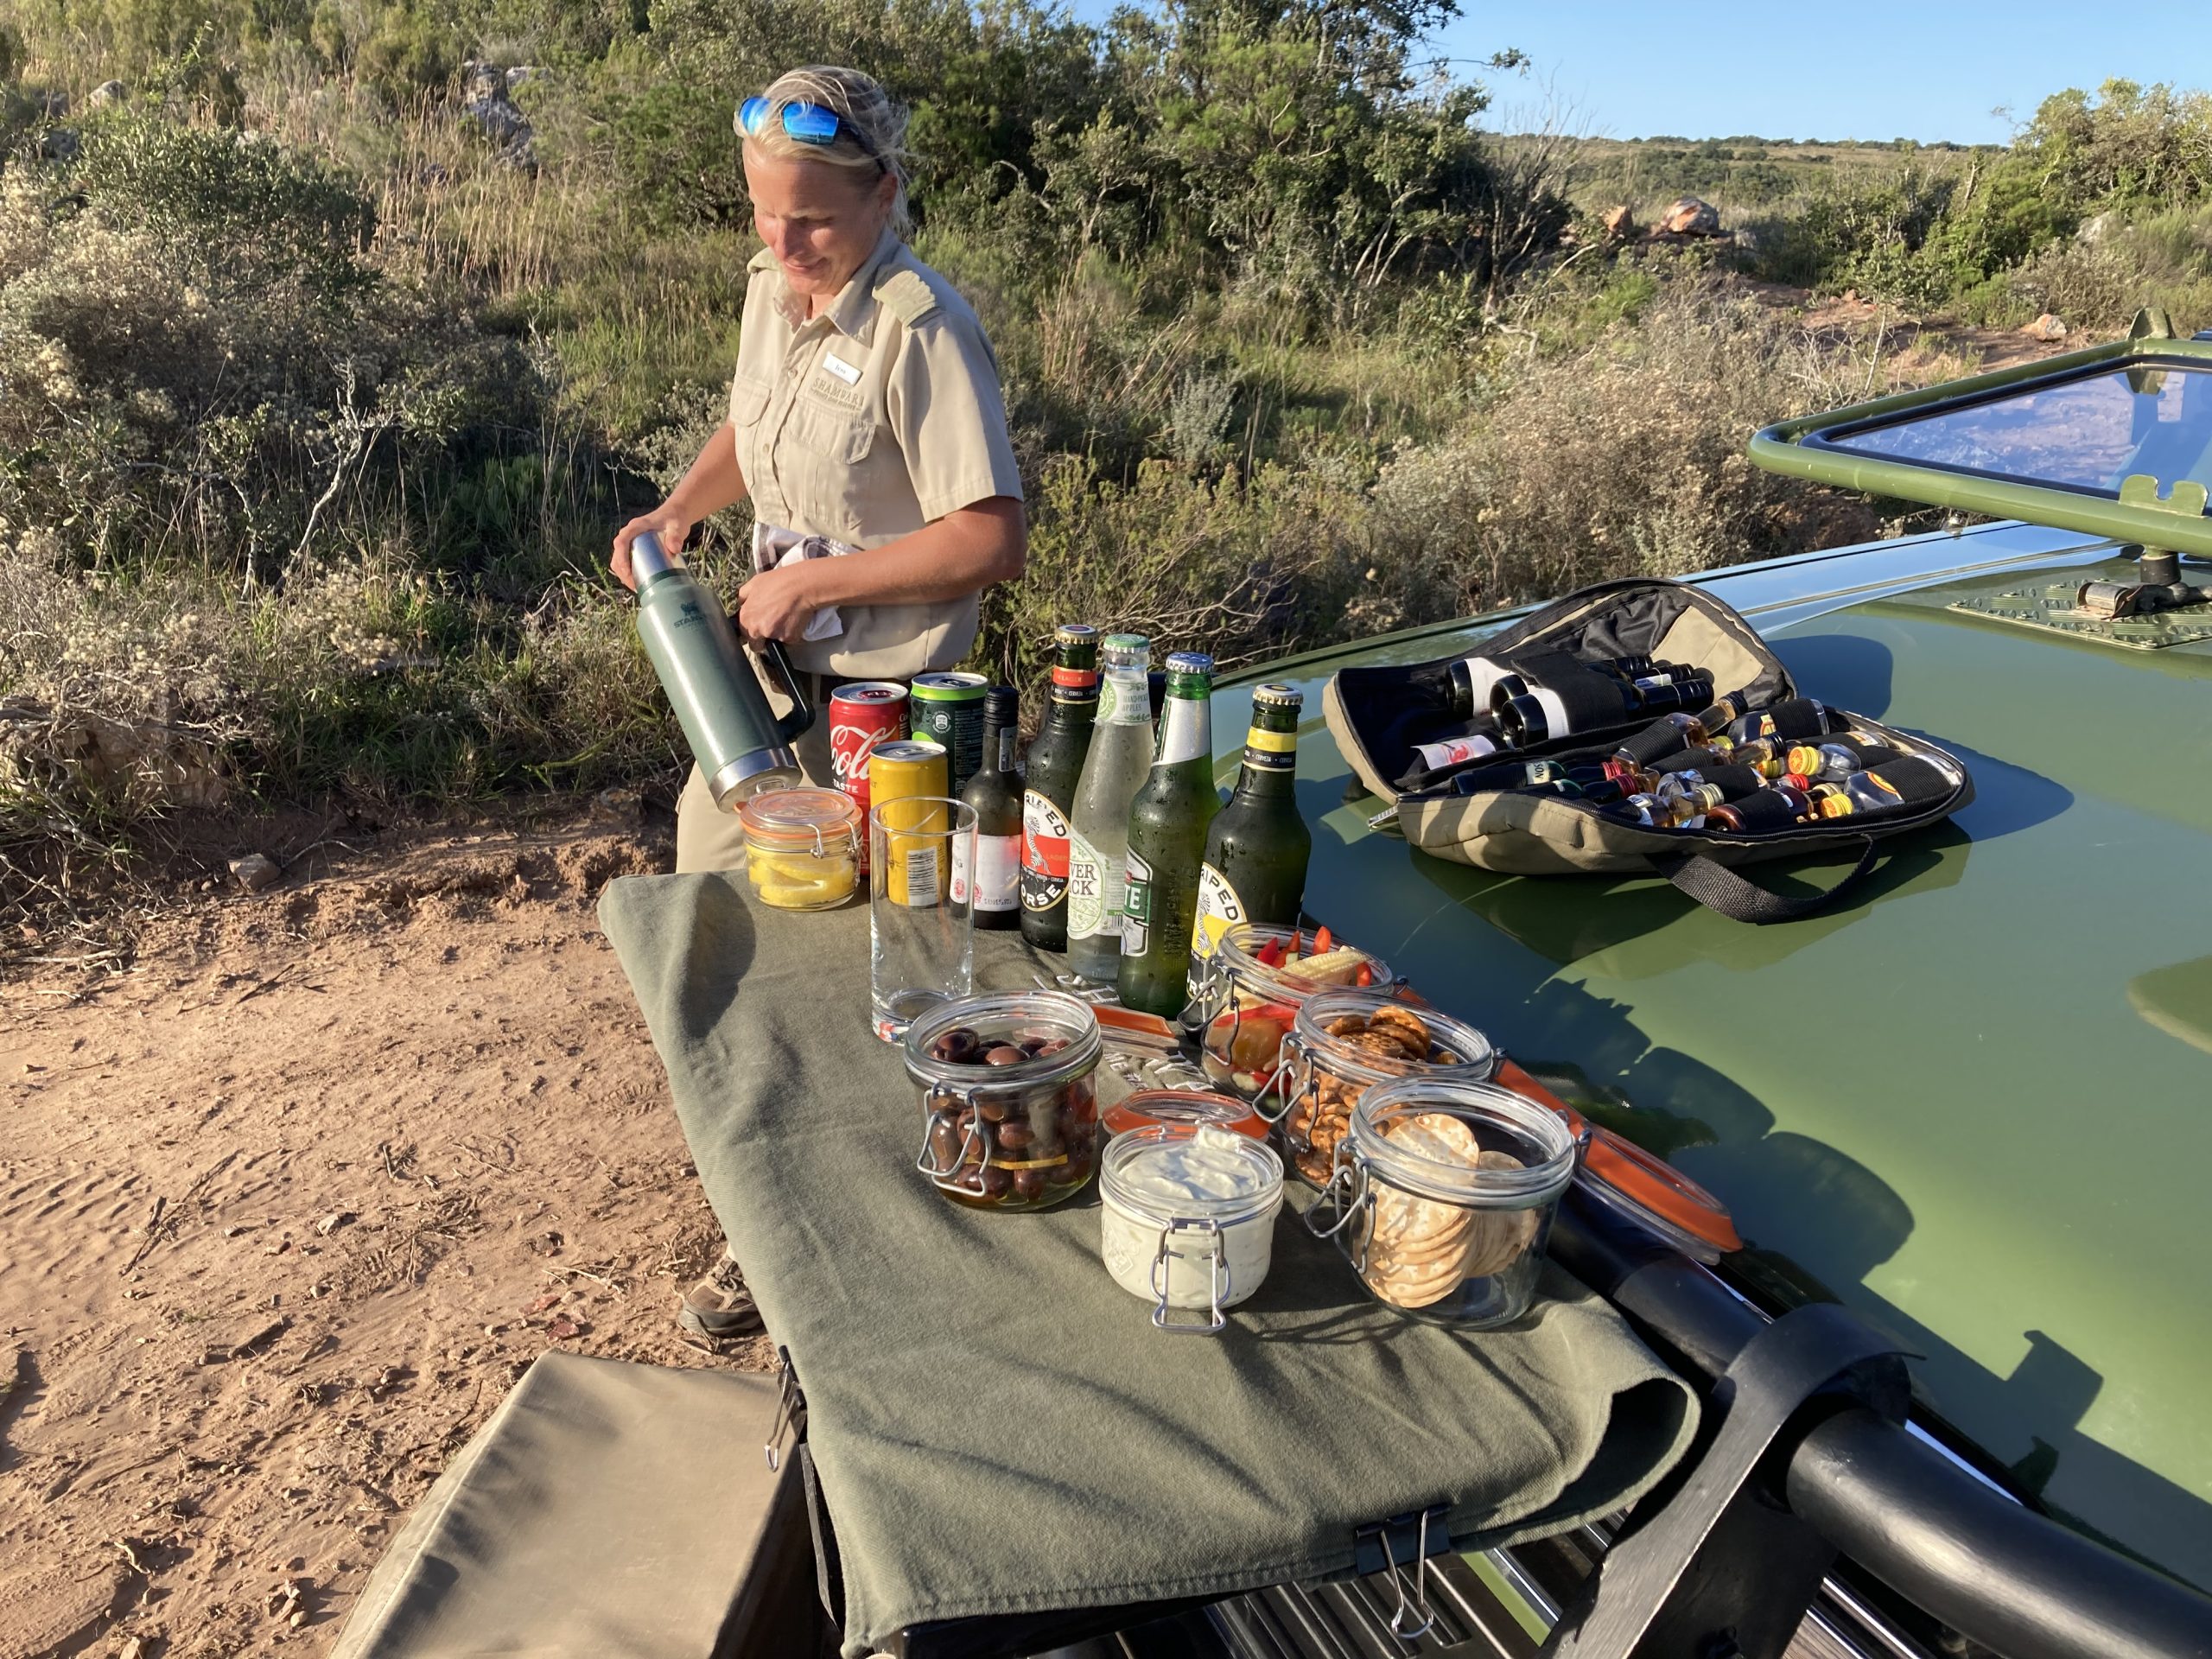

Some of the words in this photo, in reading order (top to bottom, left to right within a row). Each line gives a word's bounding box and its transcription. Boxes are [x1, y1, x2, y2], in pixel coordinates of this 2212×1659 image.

[813, 377, 865, 407] SHAMWARI
[832, 778, 859, 793] TASTE
[1070, 863, 1097, 881] VER
